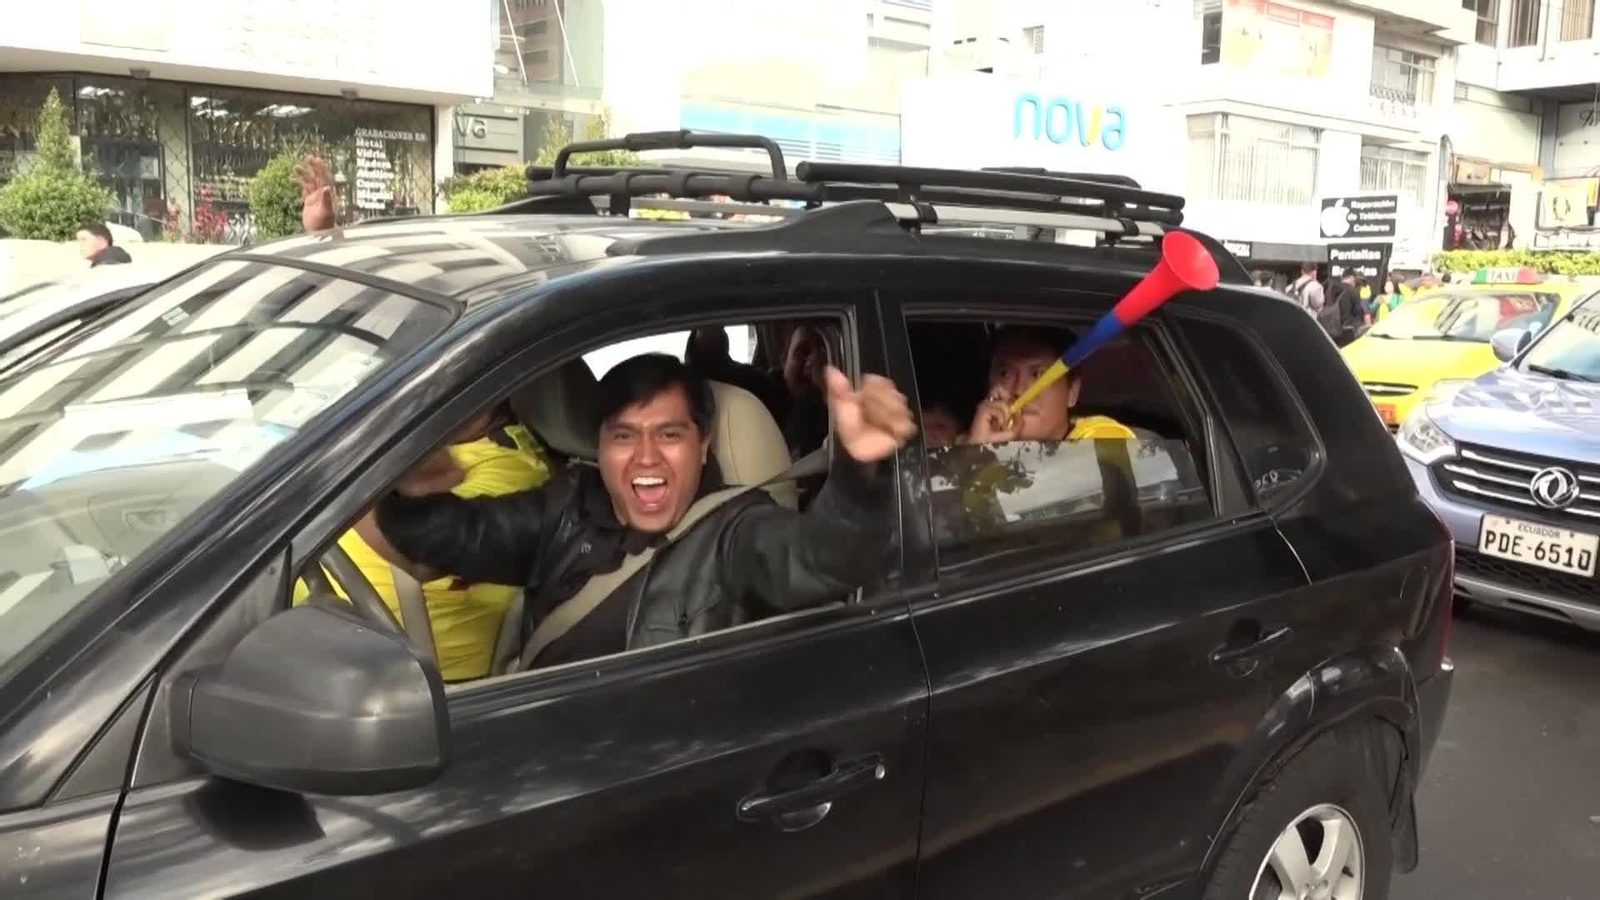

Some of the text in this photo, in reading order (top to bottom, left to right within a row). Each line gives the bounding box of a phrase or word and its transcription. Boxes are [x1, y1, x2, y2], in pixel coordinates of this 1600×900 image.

[1014, 93, 1125, 150] nova
[355, 137, 383, 148] Metal
[1347, 212, 1358, 222] de
[1330, 248, 1381, 261] Pantallas
[1517, 524, 1561, 538] ECUADOR
[1484, 529, 1592, 572] PDE-6510
